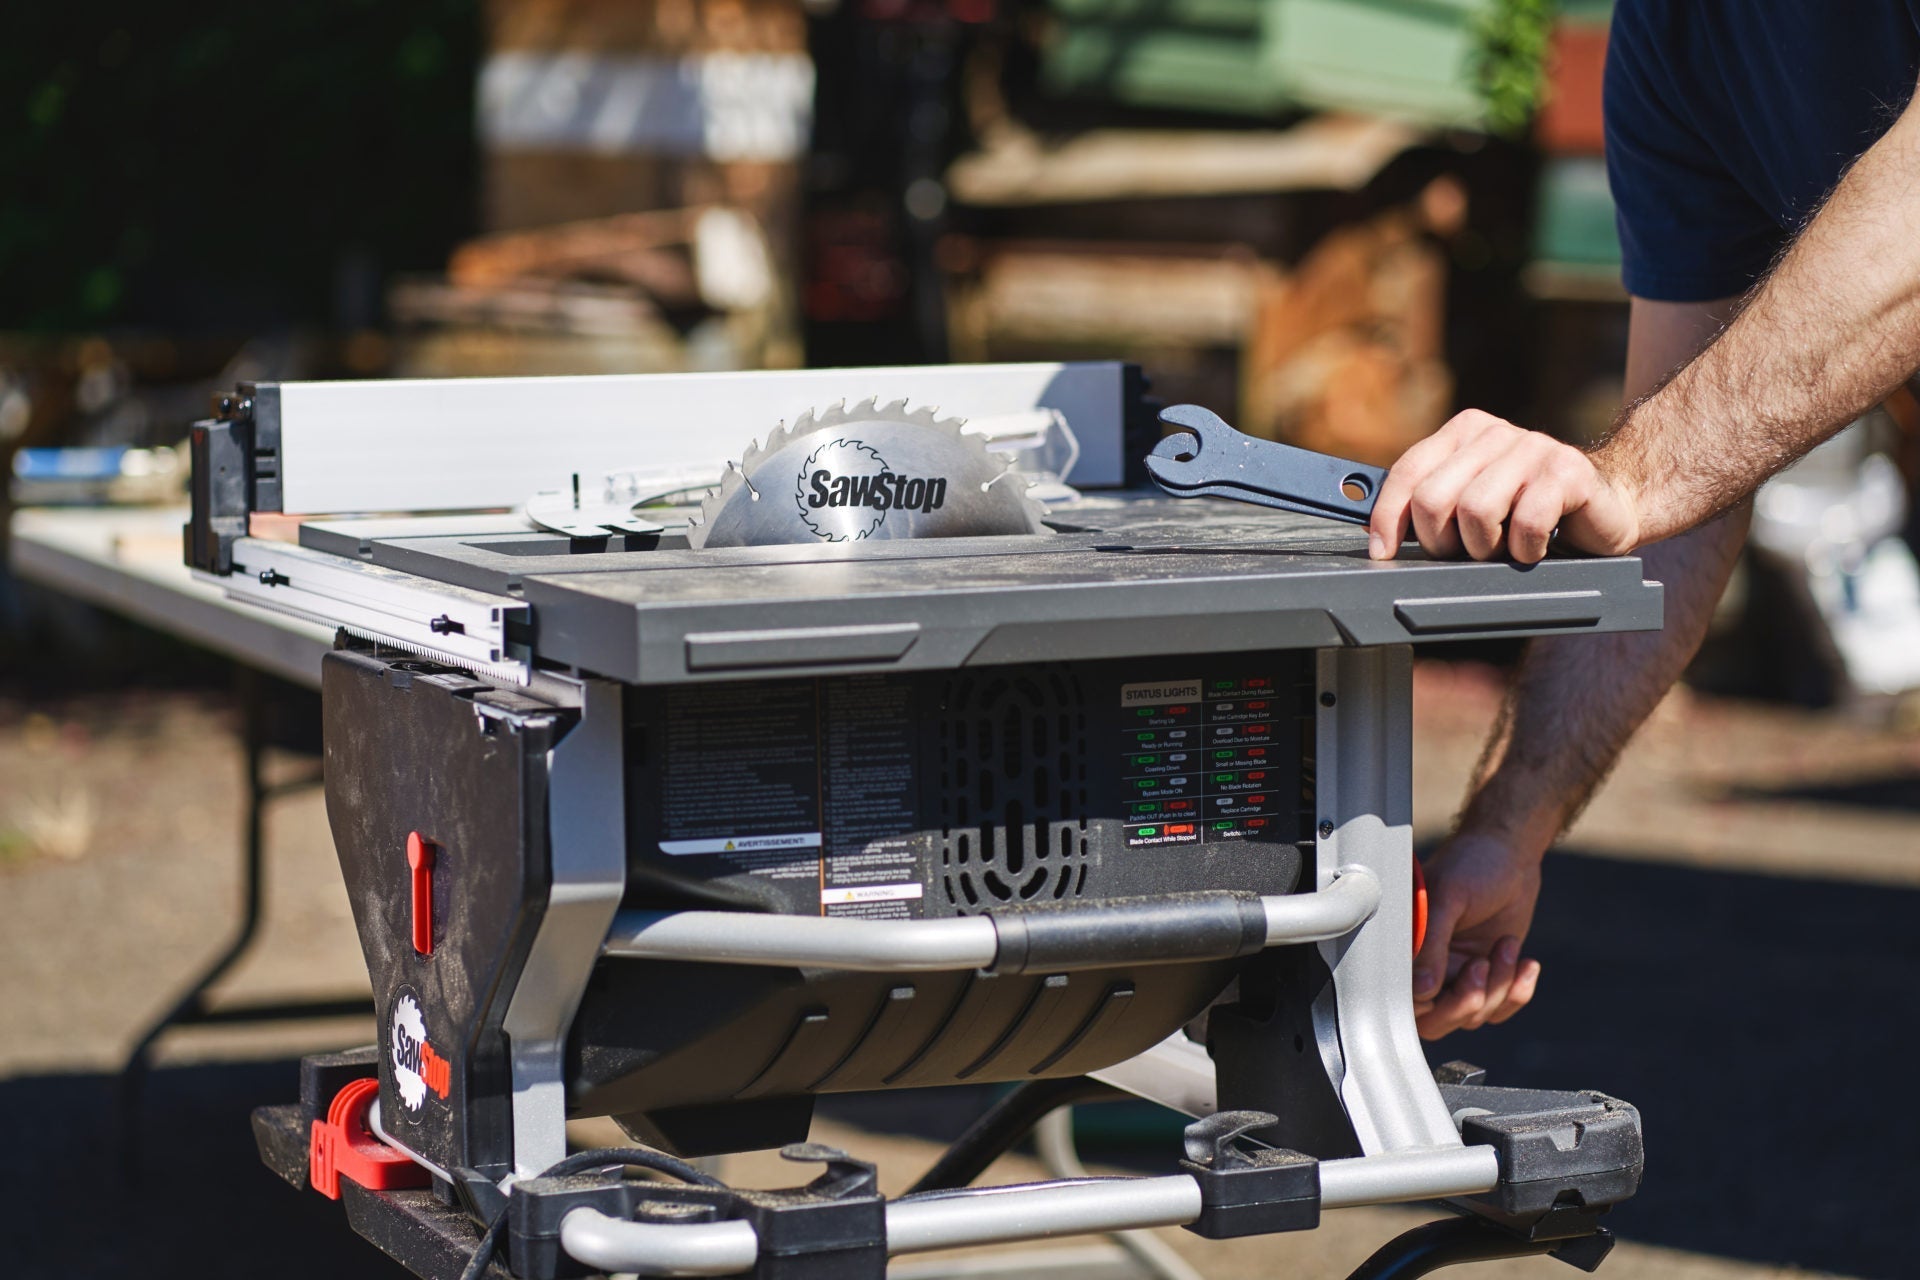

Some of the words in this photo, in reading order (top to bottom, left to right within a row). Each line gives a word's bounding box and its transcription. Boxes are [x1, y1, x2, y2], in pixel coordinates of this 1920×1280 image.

[808, 469, 947, 513] SawStop
[1126, 689, 1161, 700] STATUS
[1163, 686, 1198, 698] LIGHTS
[1129, 838, 1144, 846] Blade
[1176, 834, 1197, 842] Stopped
[397, 1023, 450, 1100] SawStop
